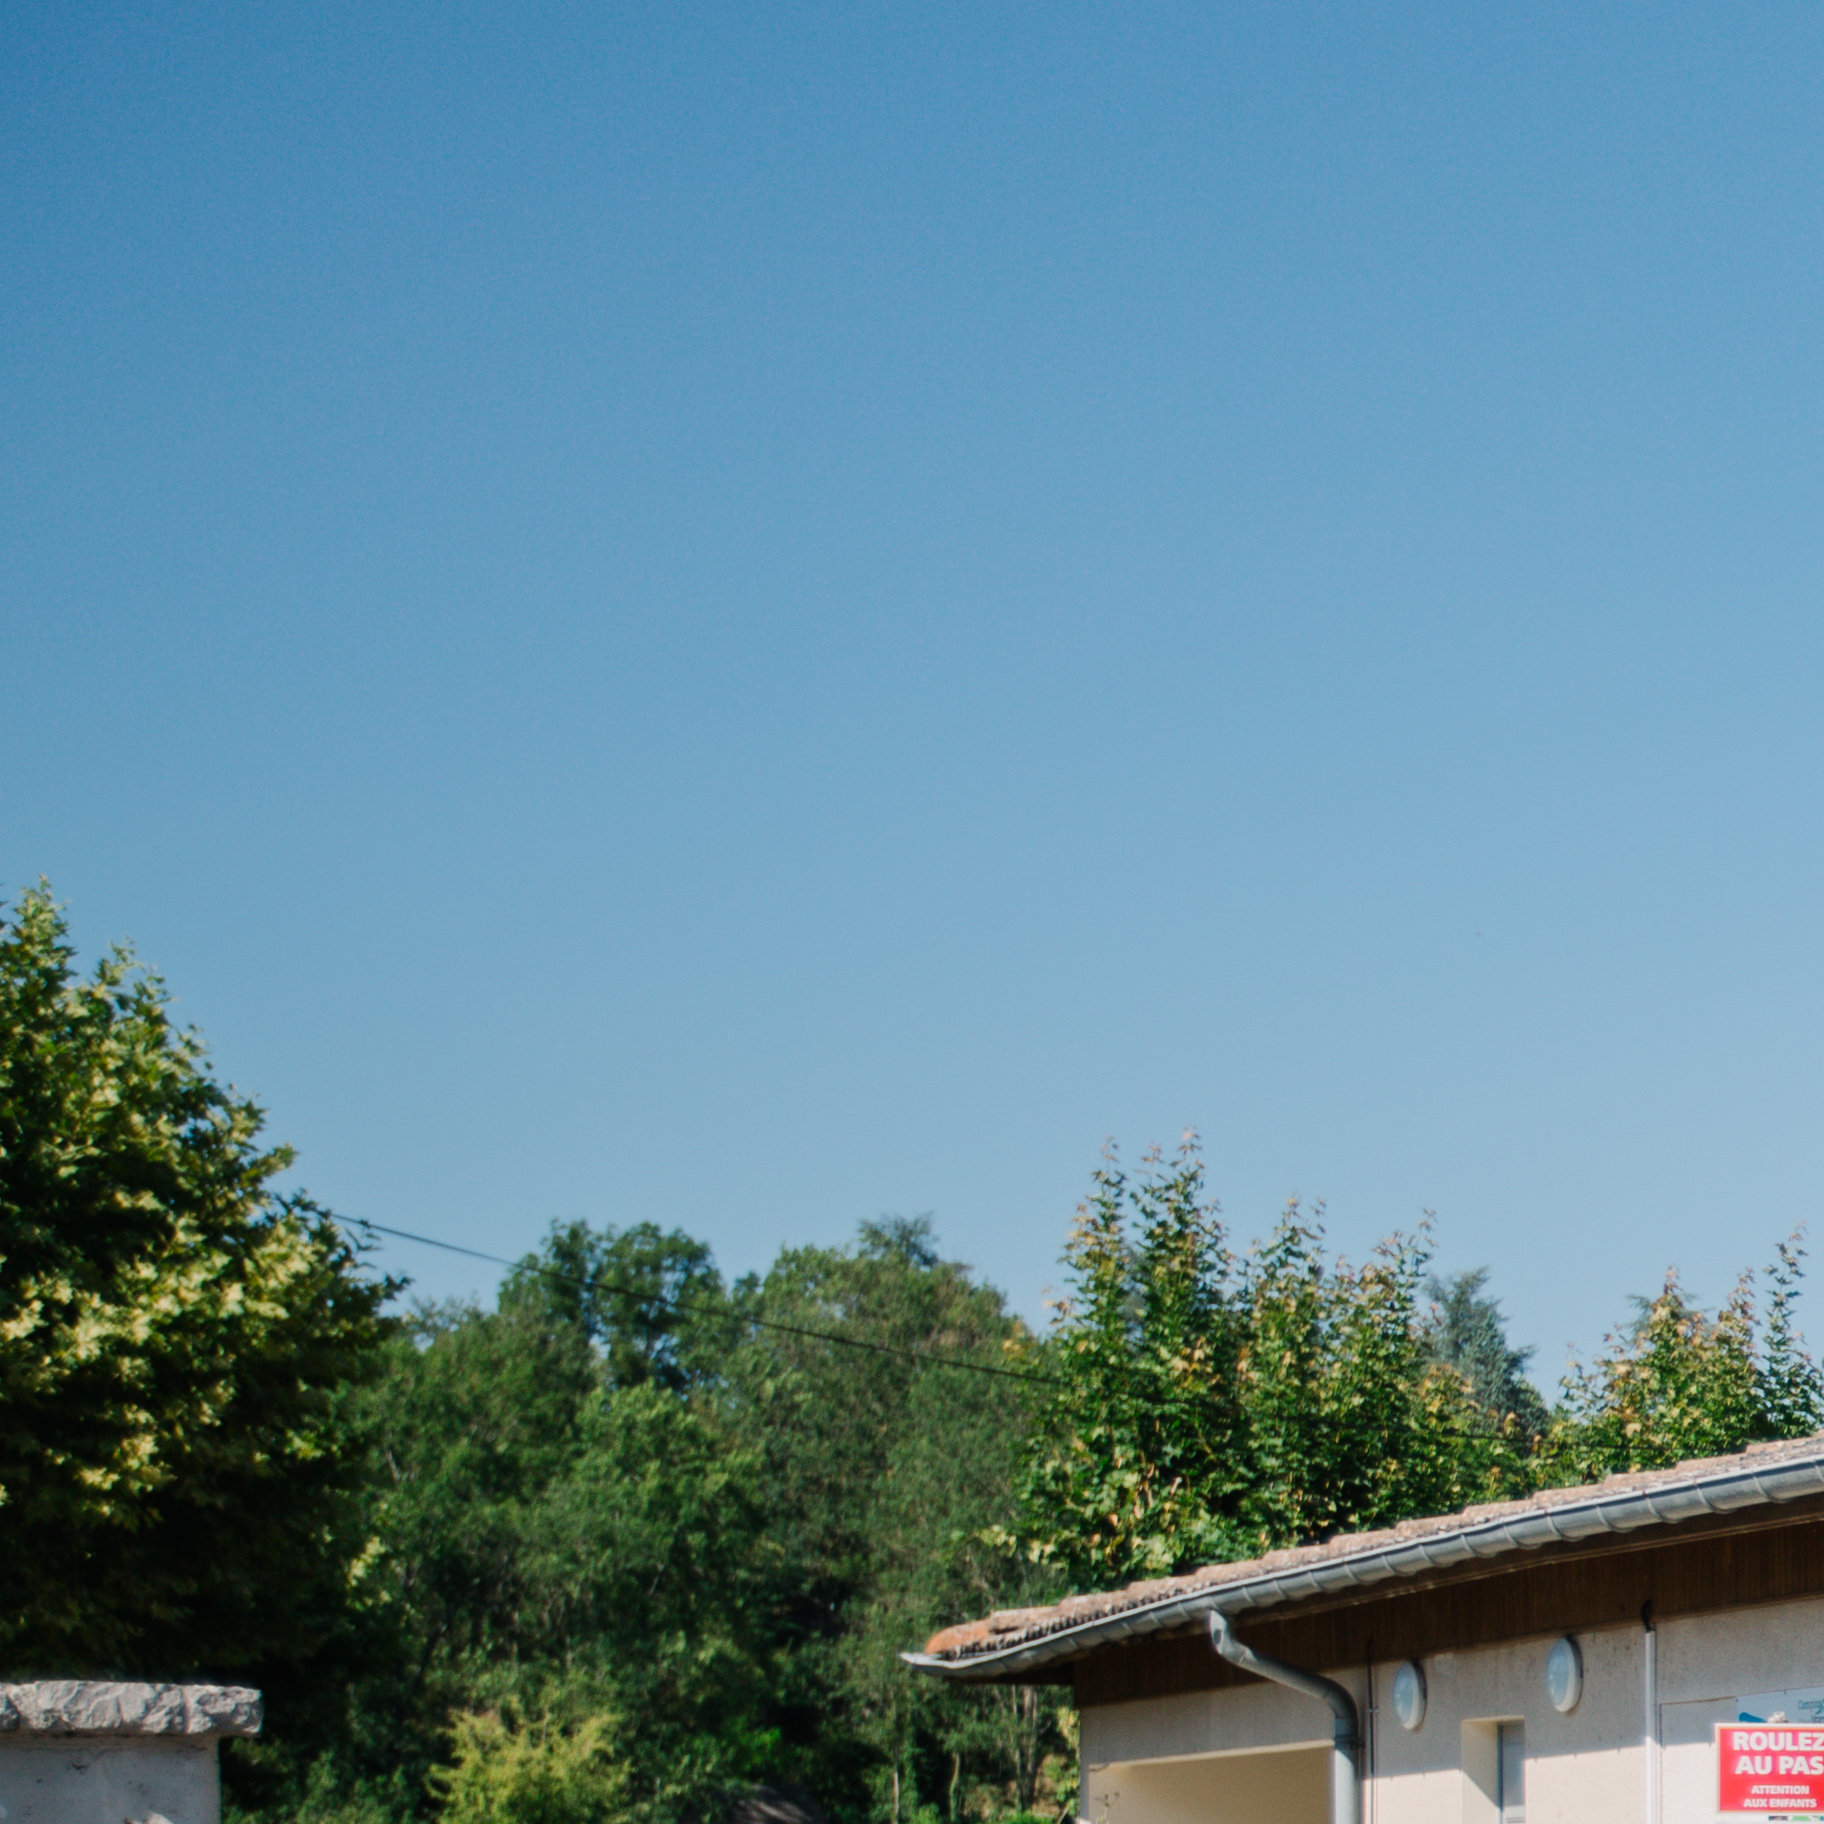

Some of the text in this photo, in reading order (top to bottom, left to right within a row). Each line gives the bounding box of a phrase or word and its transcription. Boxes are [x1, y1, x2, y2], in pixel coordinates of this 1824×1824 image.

[1735, 1755, 1824, 1775] AU PAS
[1751, 1785, 1810, 1795] ATTENTION
[1743, 1798, 1818, 1808] AUX ENFANTS
